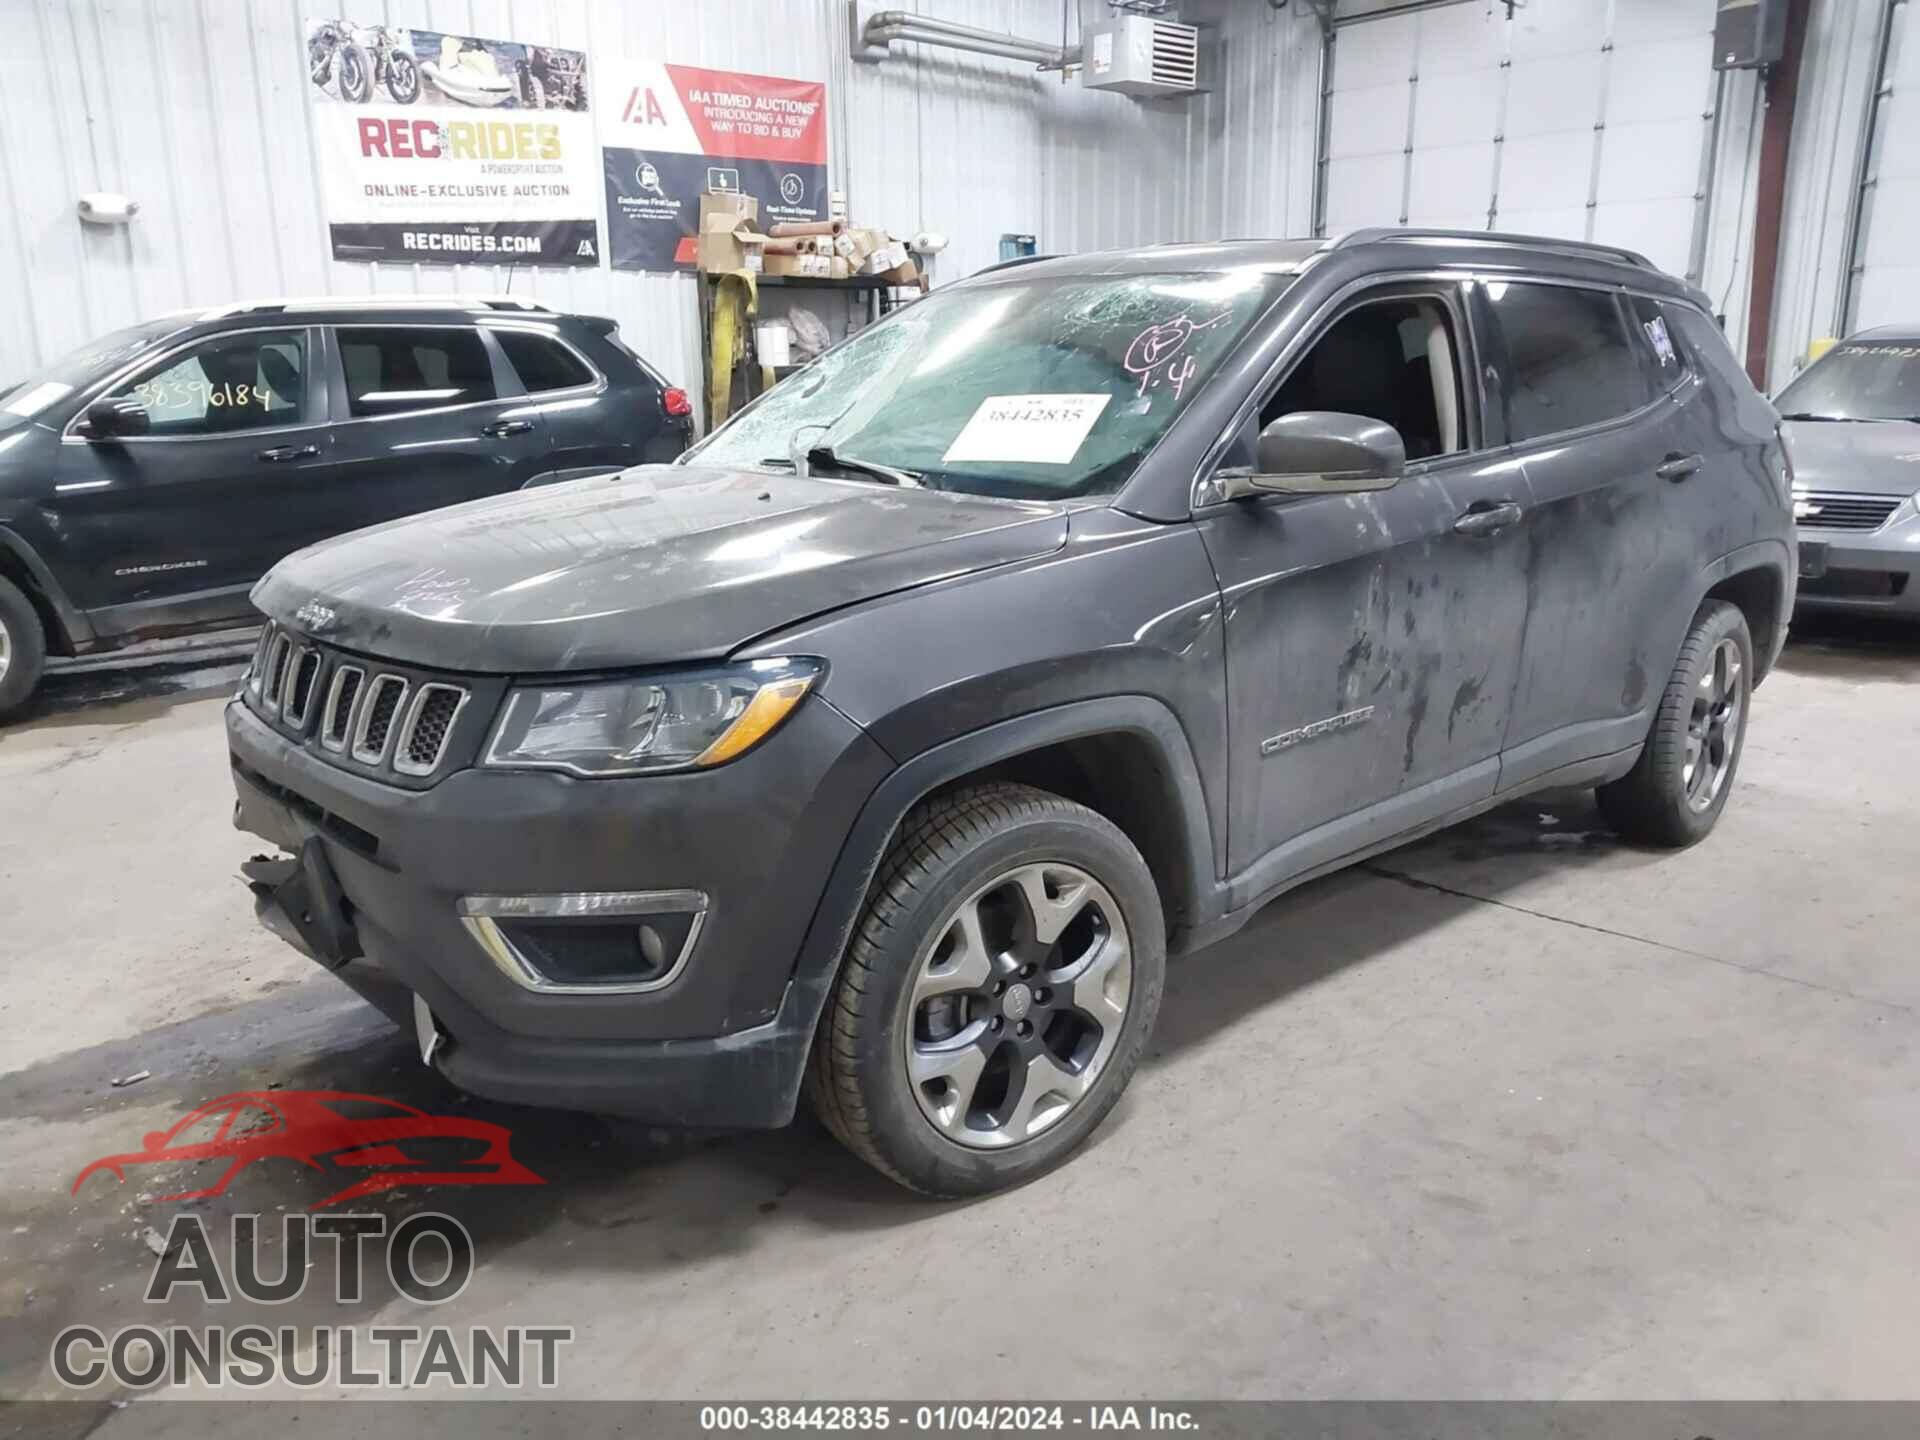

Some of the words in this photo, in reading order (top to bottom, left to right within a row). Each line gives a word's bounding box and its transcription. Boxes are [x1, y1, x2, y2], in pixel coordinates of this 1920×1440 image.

[711, 92, 752, 109] TIMED
[703, 106, 774, 124] INTRODUCING
[776, 114, 785, 125] A
[785, 115, 809, 127] NEW
[710, 121, 735, 134] WAY
[736, 123, 751, 134] TO
[782, 127, 803, 139] BUY
[364, 184, 507, 198] ONLINE-EXCLUSIVE
[512, 184, 570, 197] AUCTION
[402, 231, 542, 253] RECRIDES.COM
